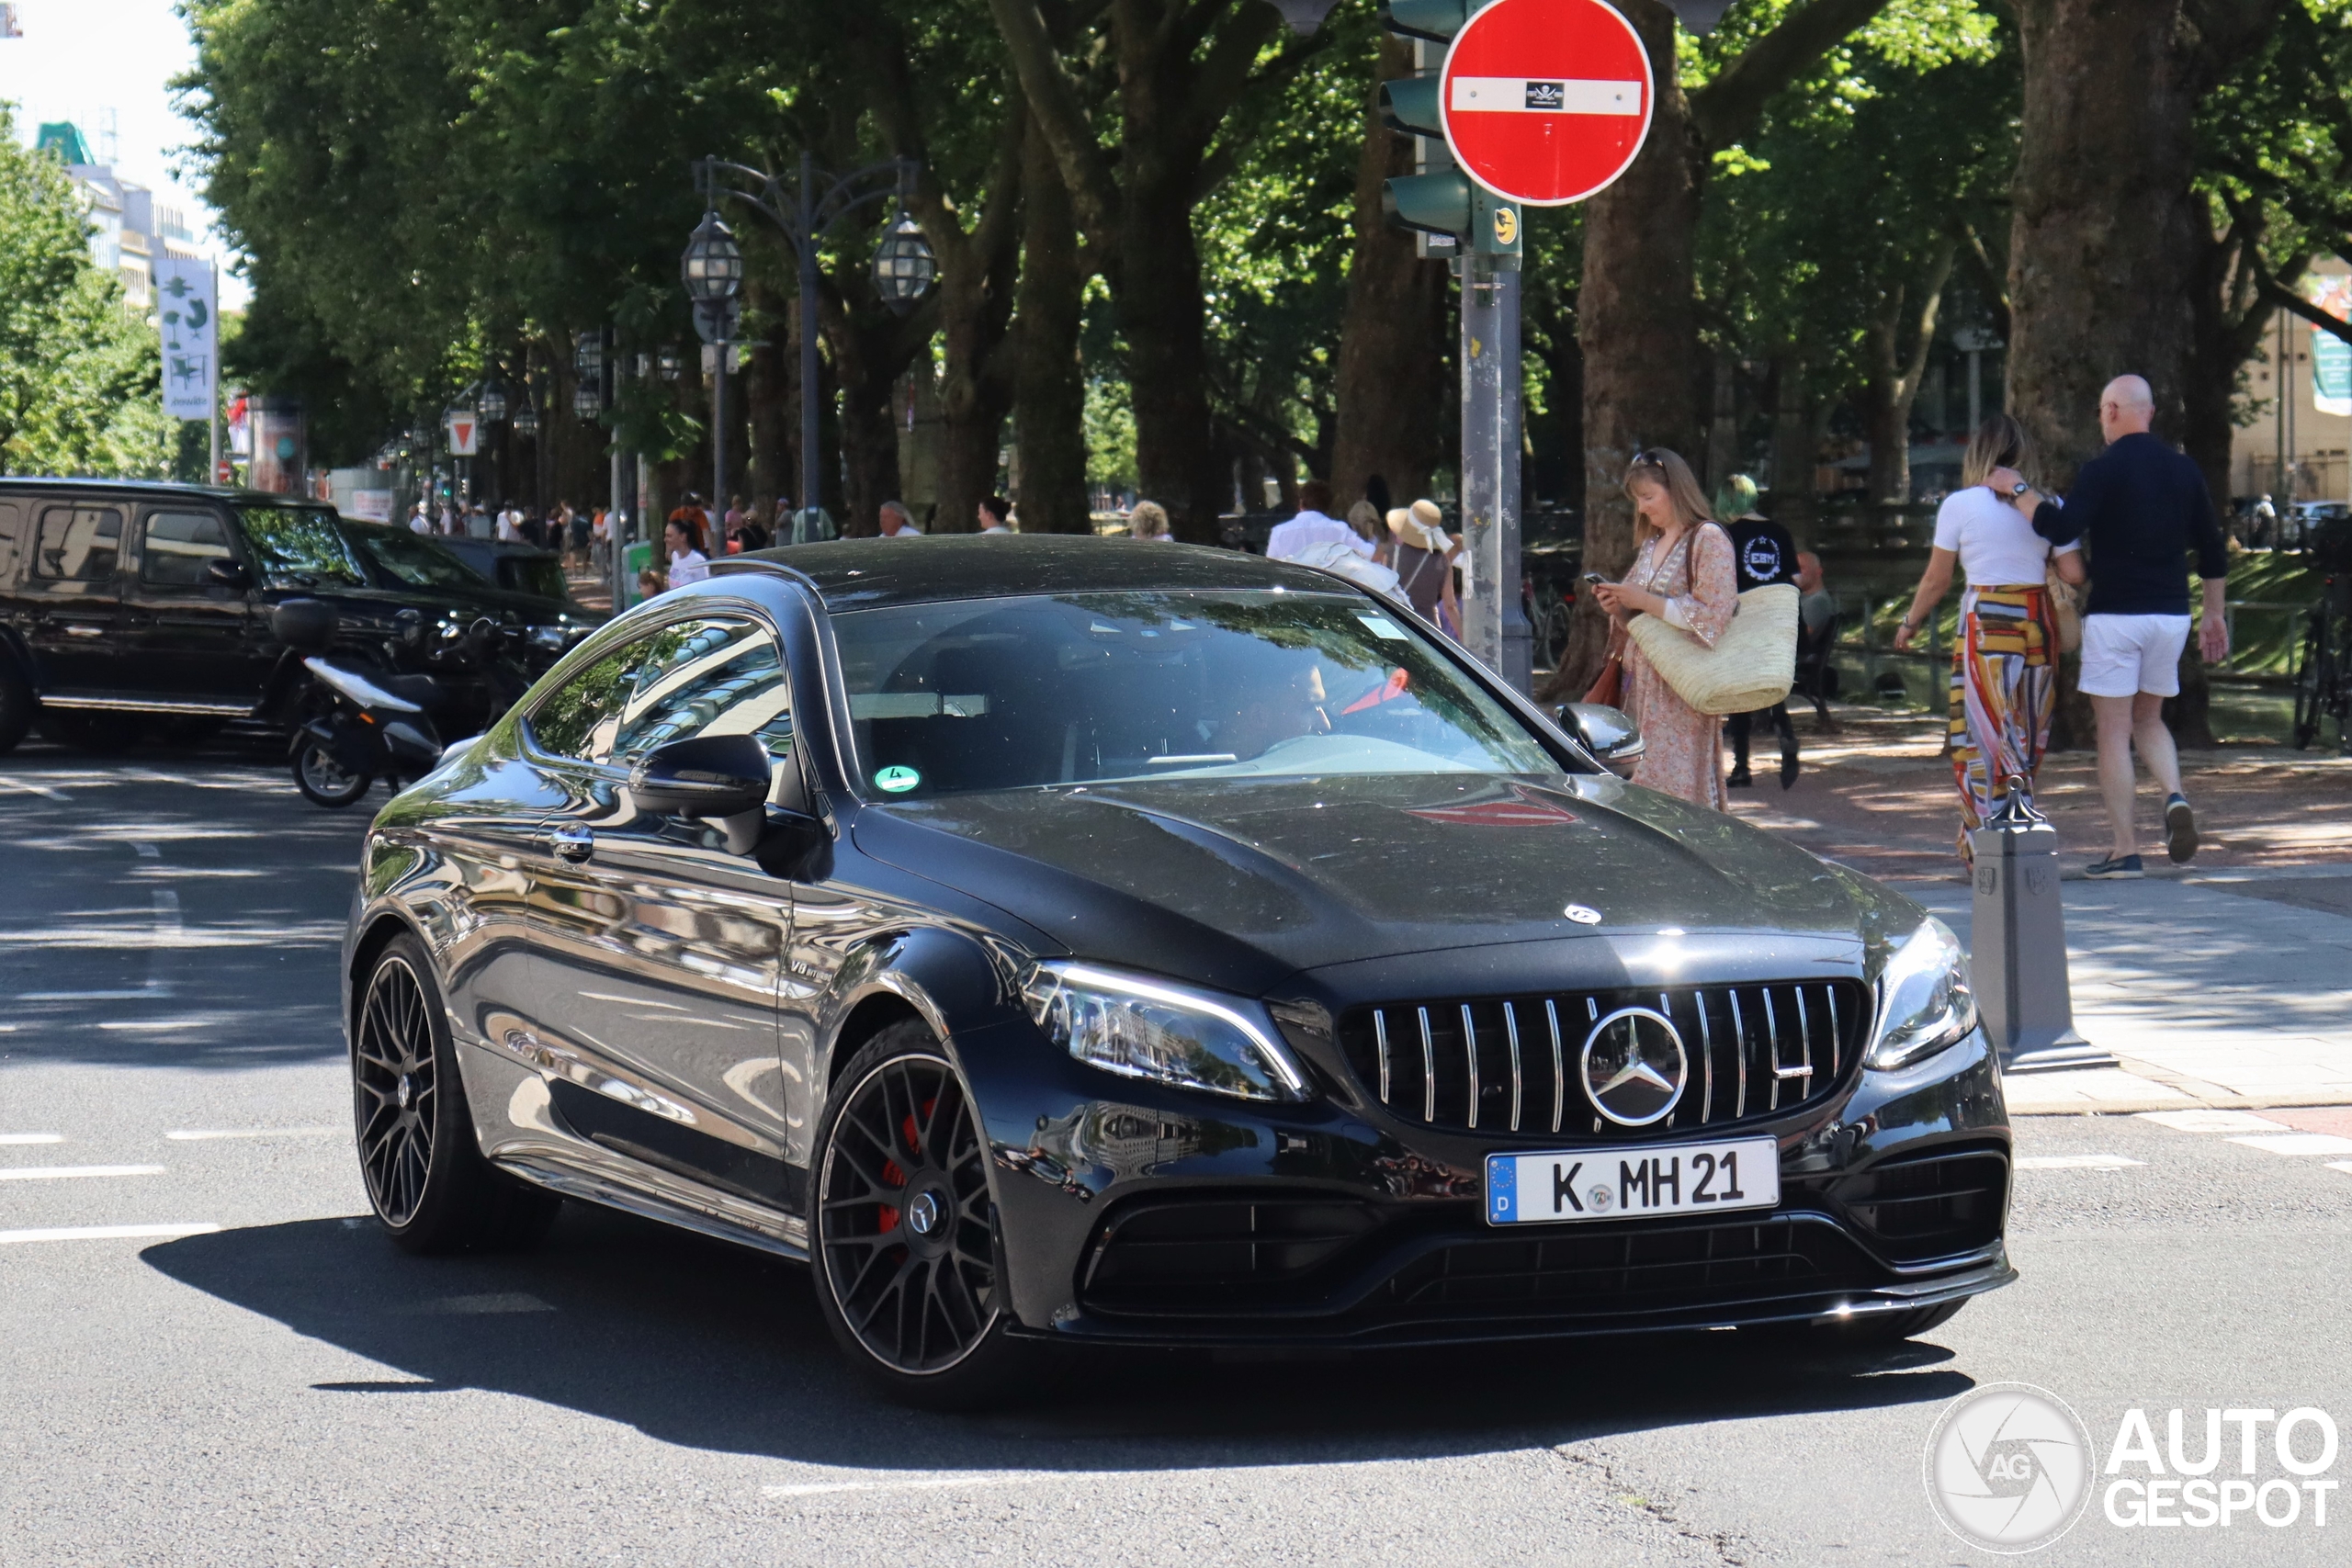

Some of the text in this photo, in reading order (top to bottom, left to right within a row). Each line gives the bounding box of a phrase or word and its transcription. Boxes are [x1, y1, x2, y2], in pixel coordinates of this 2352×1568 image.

[1750, 553, 1776, 565] EBM
[889, 767, 902, 779] 4
[790, 960, 833, 982] V8 BITURBO
[1554, 1162, 1584, 1213] K
[1498, 1197, 1509, 1212] D
